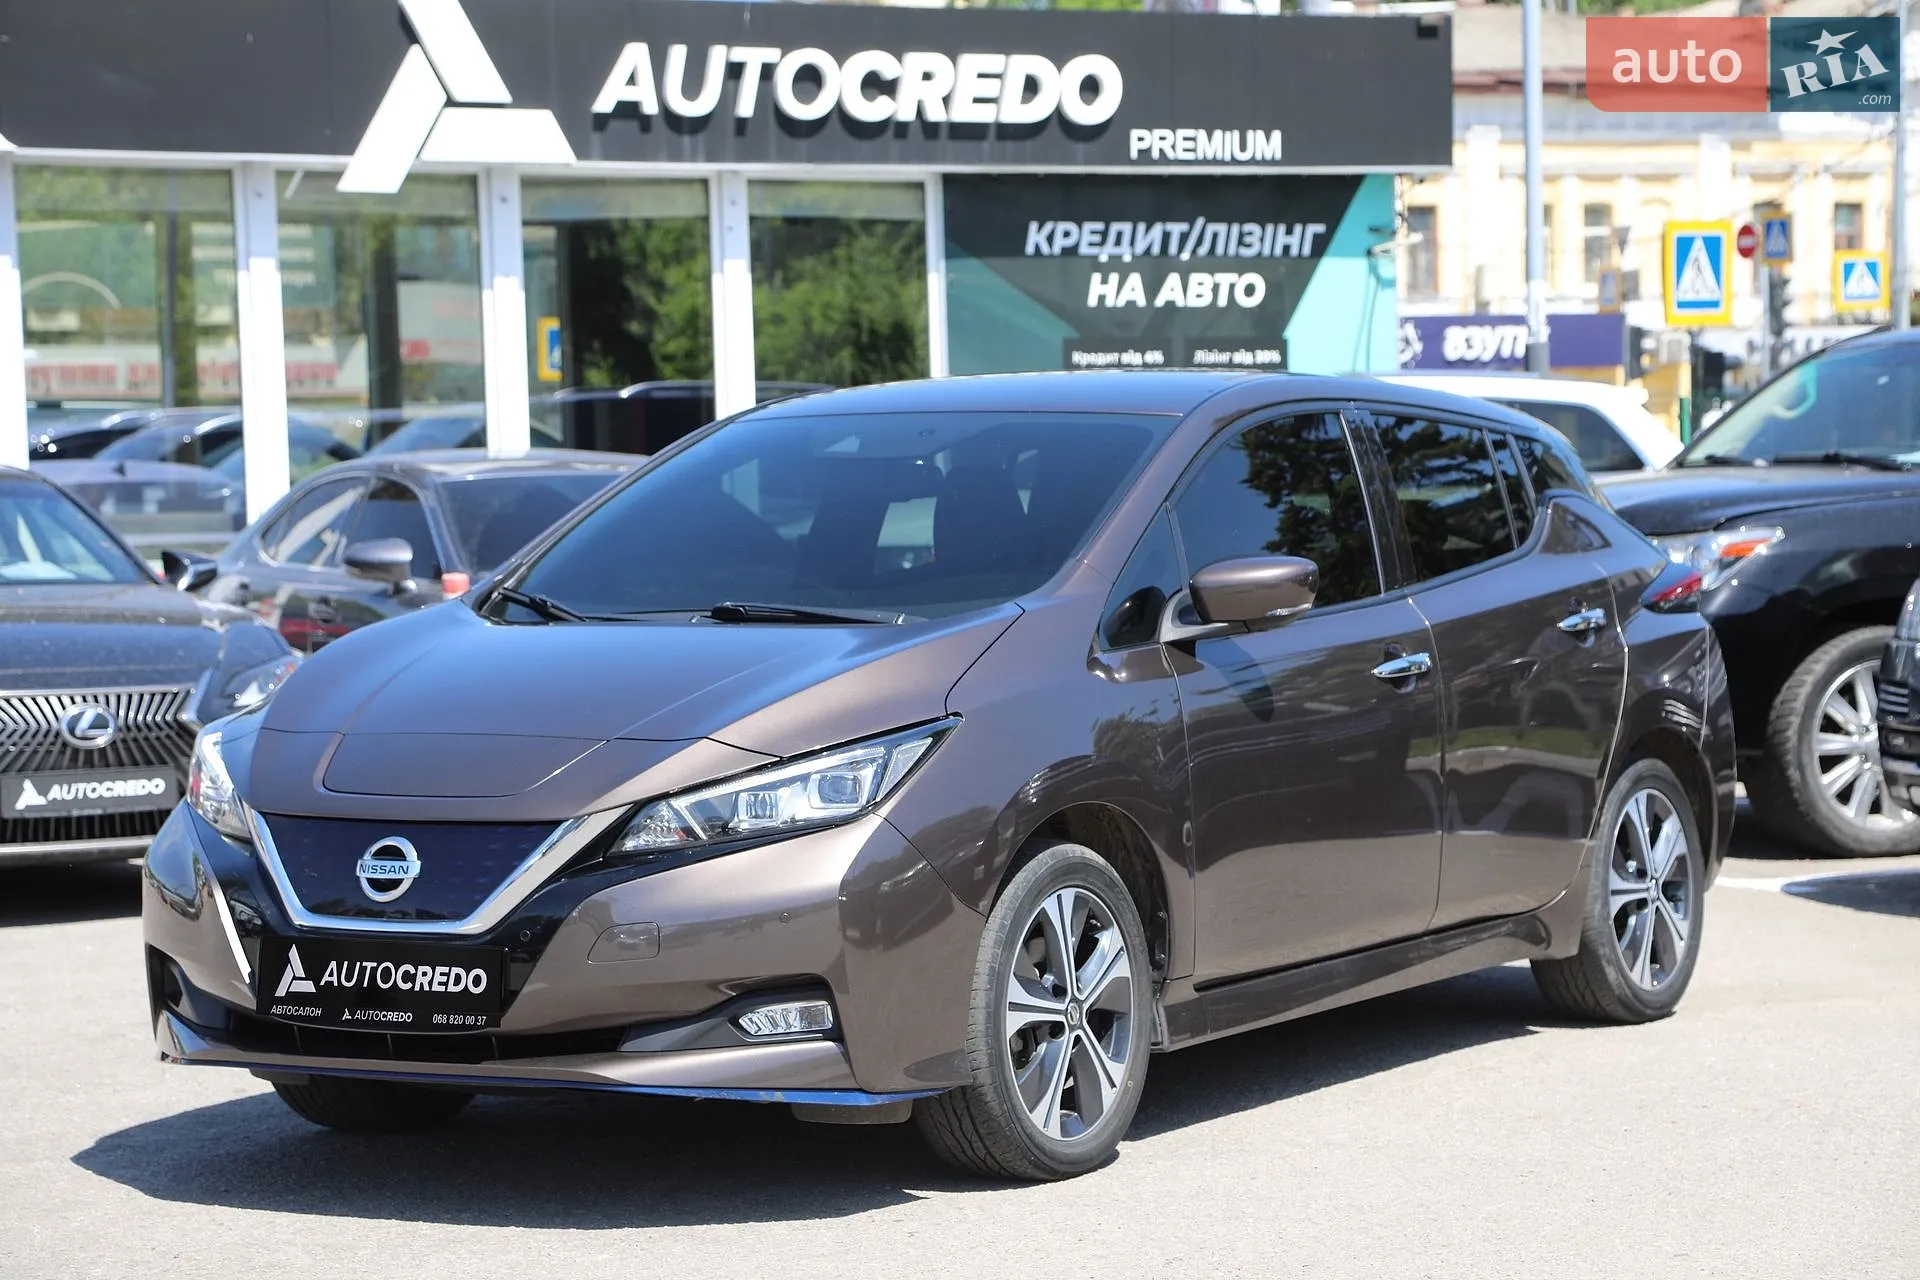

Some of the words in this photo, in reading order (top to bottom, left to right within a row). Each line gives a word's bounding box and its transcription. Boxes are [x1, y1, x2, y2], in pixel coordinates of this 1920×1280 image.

[591, 42, 1124, 126] AUTOCREDO
[1129, 128, 1282, 162] PREMIUM
[1024, 216, 1327, 262] КРЕДИТ/ЛІЗІНГ
[1087, 272, 1147, 308] НА
[1153, 272, 1266, 308] АВТО
[46, 778, 166, 801] AUTOCREDO
[359, 862, 410, 876] NISSAN
[319, 960, 488, 995] AUTOCREDO
[270, 1005, 322, 1018] АВТОСАЛОН
[353, 1010, 413, 1023] AUTOCREDO
[432, 1014, 448, 1024] 068
[448, 1014, 464, 1025] 820
[464, 1015, 475, 1025] 00
[476, 1015, 487, 1026] 37
